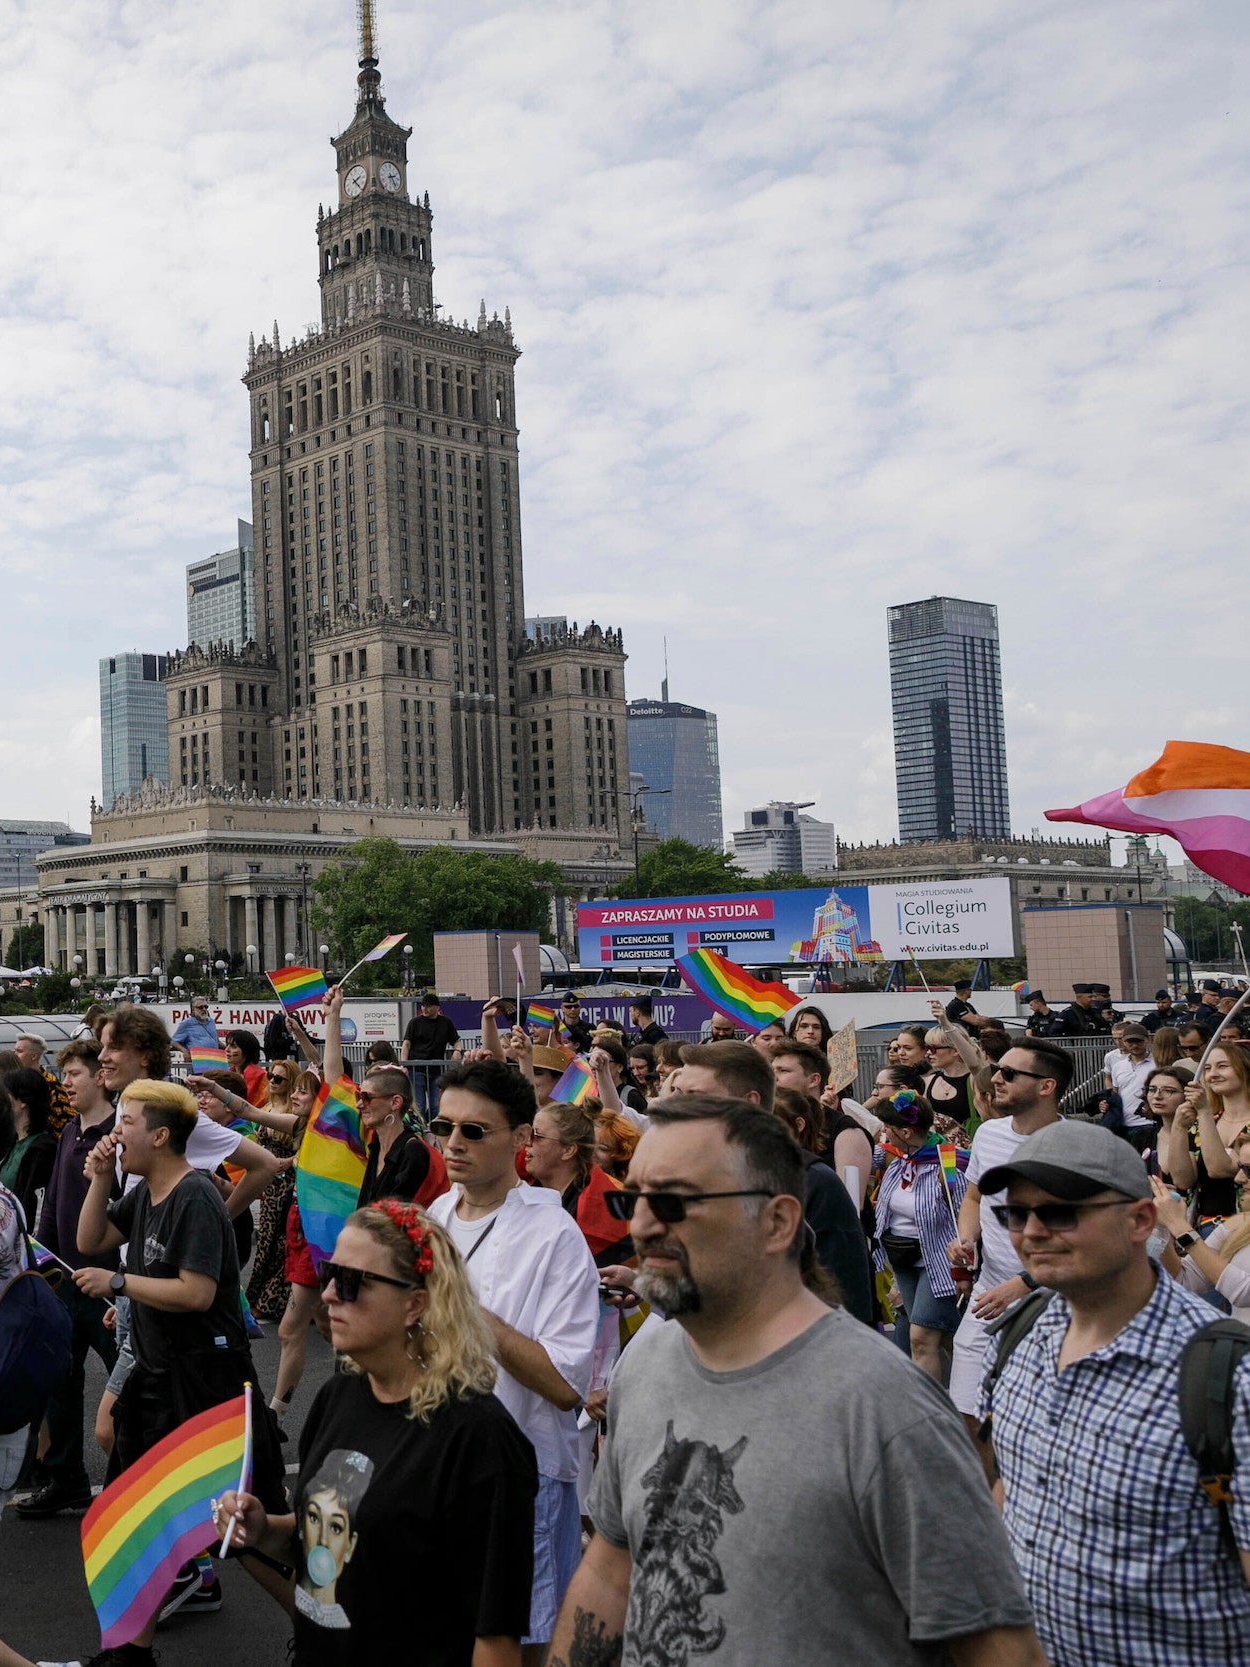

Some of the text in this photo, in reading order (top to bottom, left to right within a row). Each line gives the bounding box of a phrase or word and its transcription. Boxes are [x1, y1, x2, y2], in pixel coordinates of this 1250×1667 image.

[630, 707, 664, 715] Deloitte
[895, 887, 973, 898] MAGIA STUDIOWANIA
[601, 903, 759, 924] ZAPRASZAMY NA STUDIA
[904, 899, 987, 918] Collegium
[905, 920, 960, 935] Civitas
[616, 935, 670, 944] LICENCJACKIE
[704, 931, 770, 941] PODYPLOMOWE
[900, 942, 989, 953] www.civitas.edu.pl
[617, 949, 670, 959] MAGISTERSKIE
